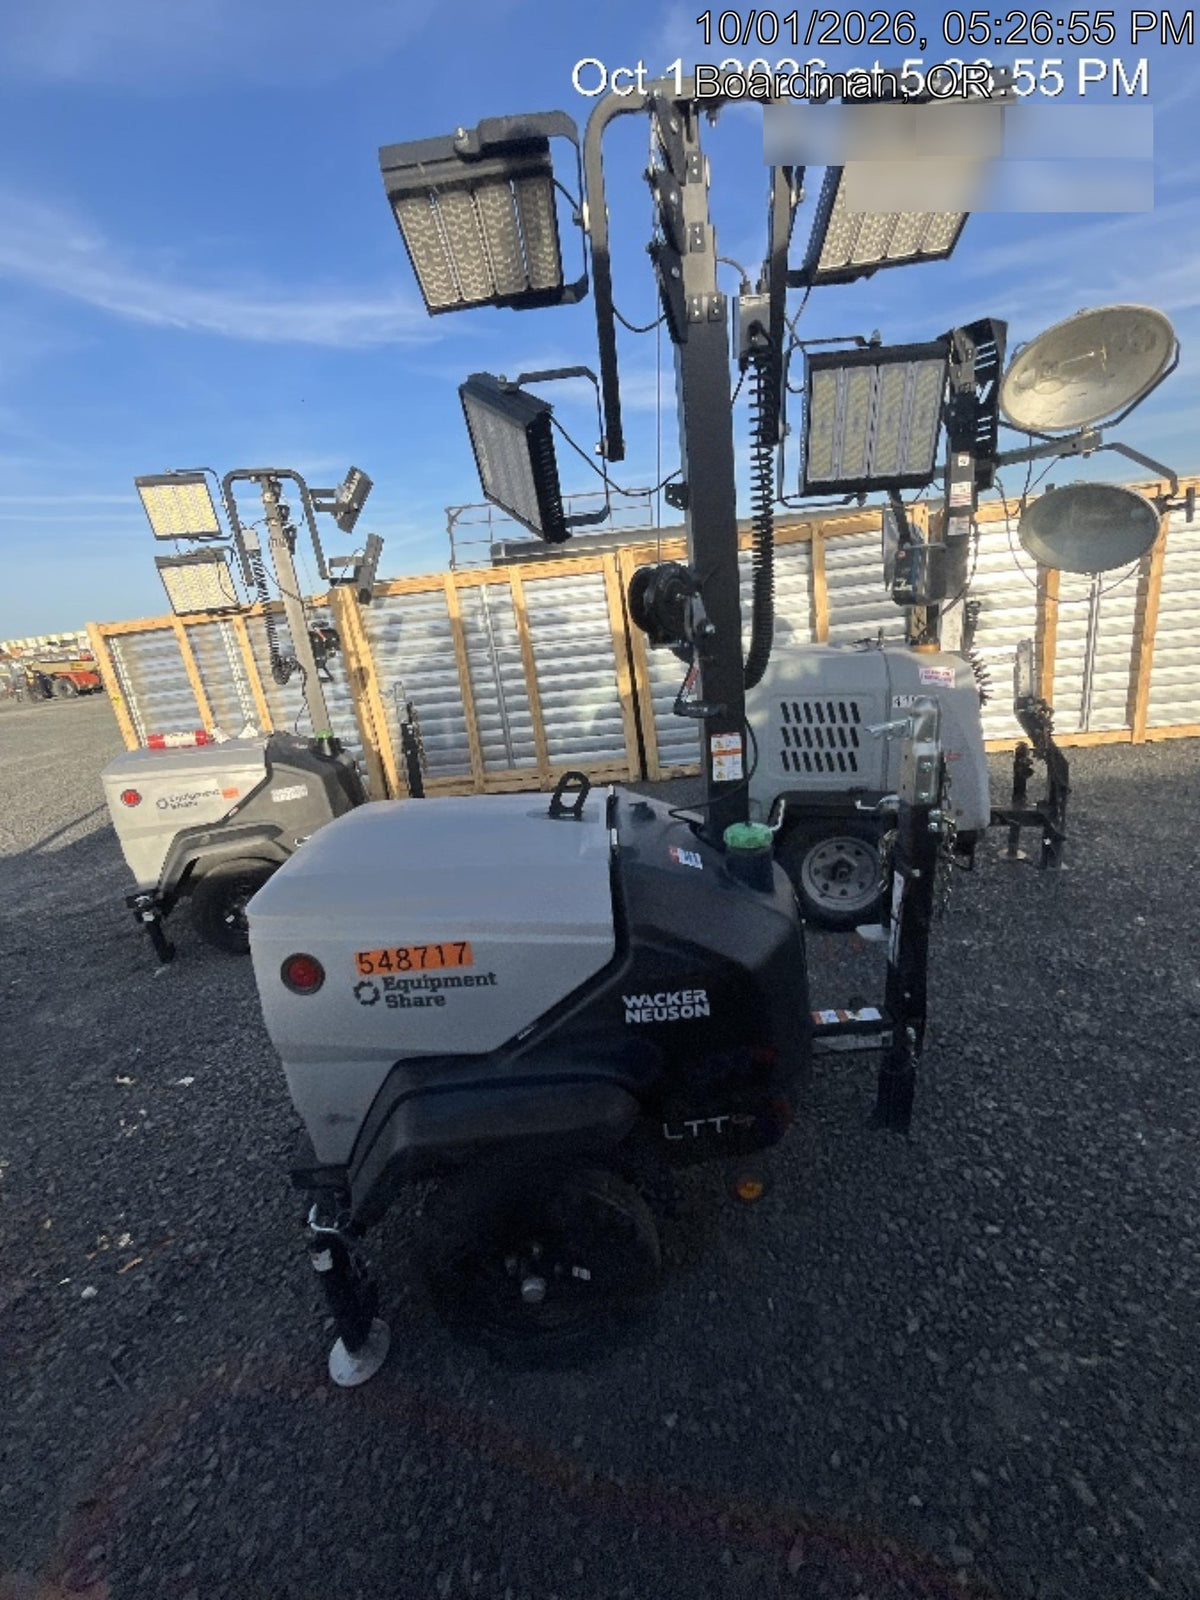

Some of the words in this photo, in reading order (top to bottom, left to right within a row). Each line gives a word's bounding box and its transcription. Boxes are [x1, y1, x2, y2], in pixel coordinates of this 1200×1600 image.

[357, 942, 467, 975] 548717
[382, 971, 498, 994] Equipment
[385, 994, 447, 1008] Share
[622, 989, 709, 1008] WACKER
[625, 1002, 710, 1024] NEUSON
